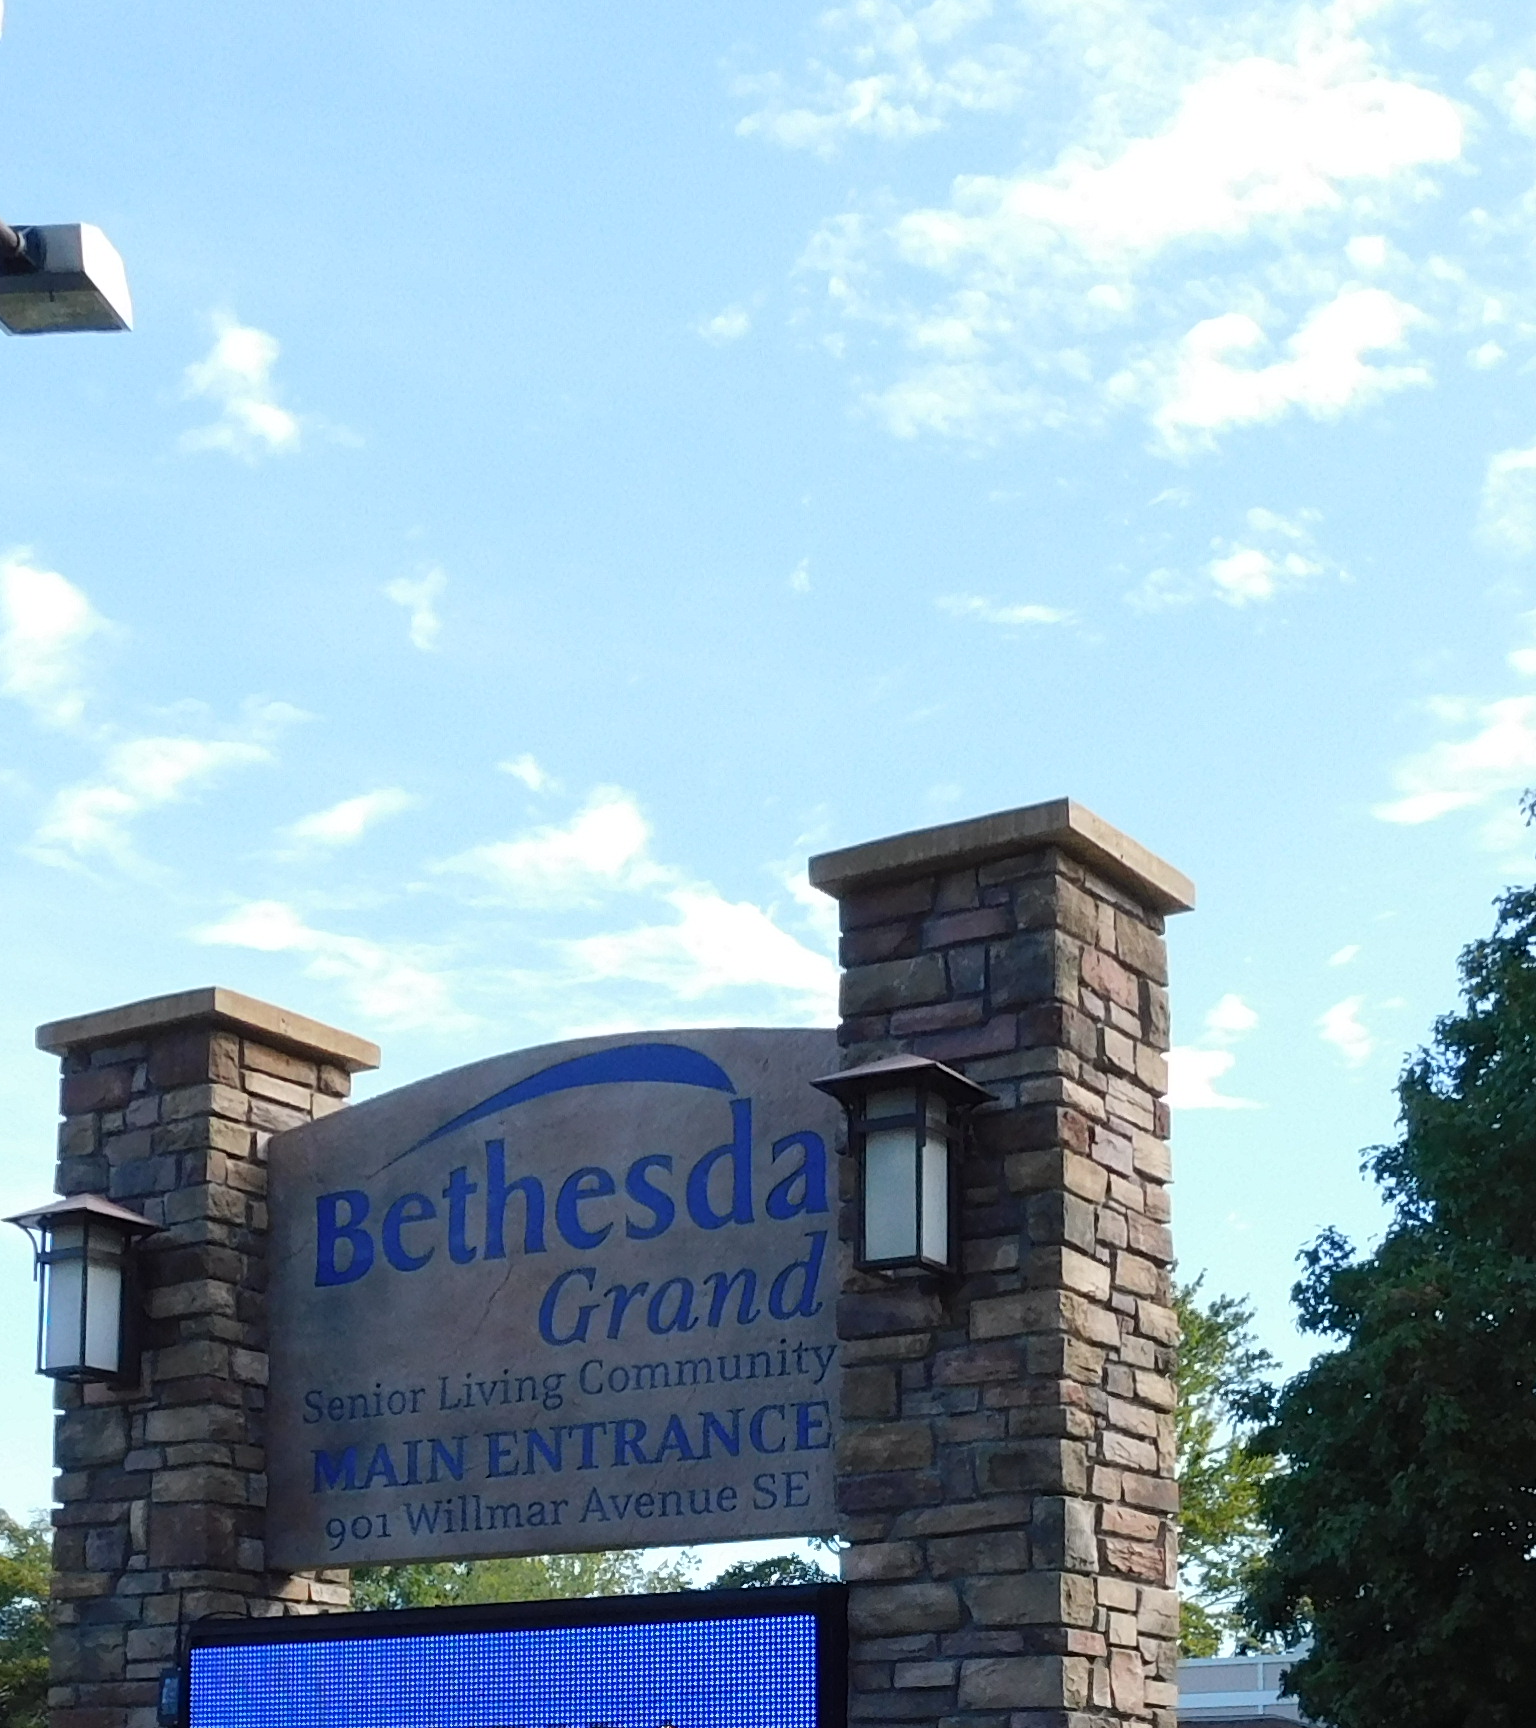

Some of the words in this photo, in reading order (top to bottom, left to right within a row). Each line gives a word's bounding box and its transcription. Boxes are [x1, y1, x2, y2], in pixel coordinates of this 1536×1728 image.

[315, 1098, 830, 1287] Bethesda
[538, 1230, 827, 1346] Grand
[302, 1381, 426, 1424] Senior
[437, 1367, 565, 1412] Living
[579, 1338, 837, 1396] Community
[310, 1435, 467, 1494] MAIN
[485, 1400, 833, 1479] ENTRANCE
[325, 1511, 391, 1551] 901
[405, 1495, 568, 1538] Willmar
[579, 1486, 737, 1524] Avenue
[752, 1471, 811, 1510] SE
